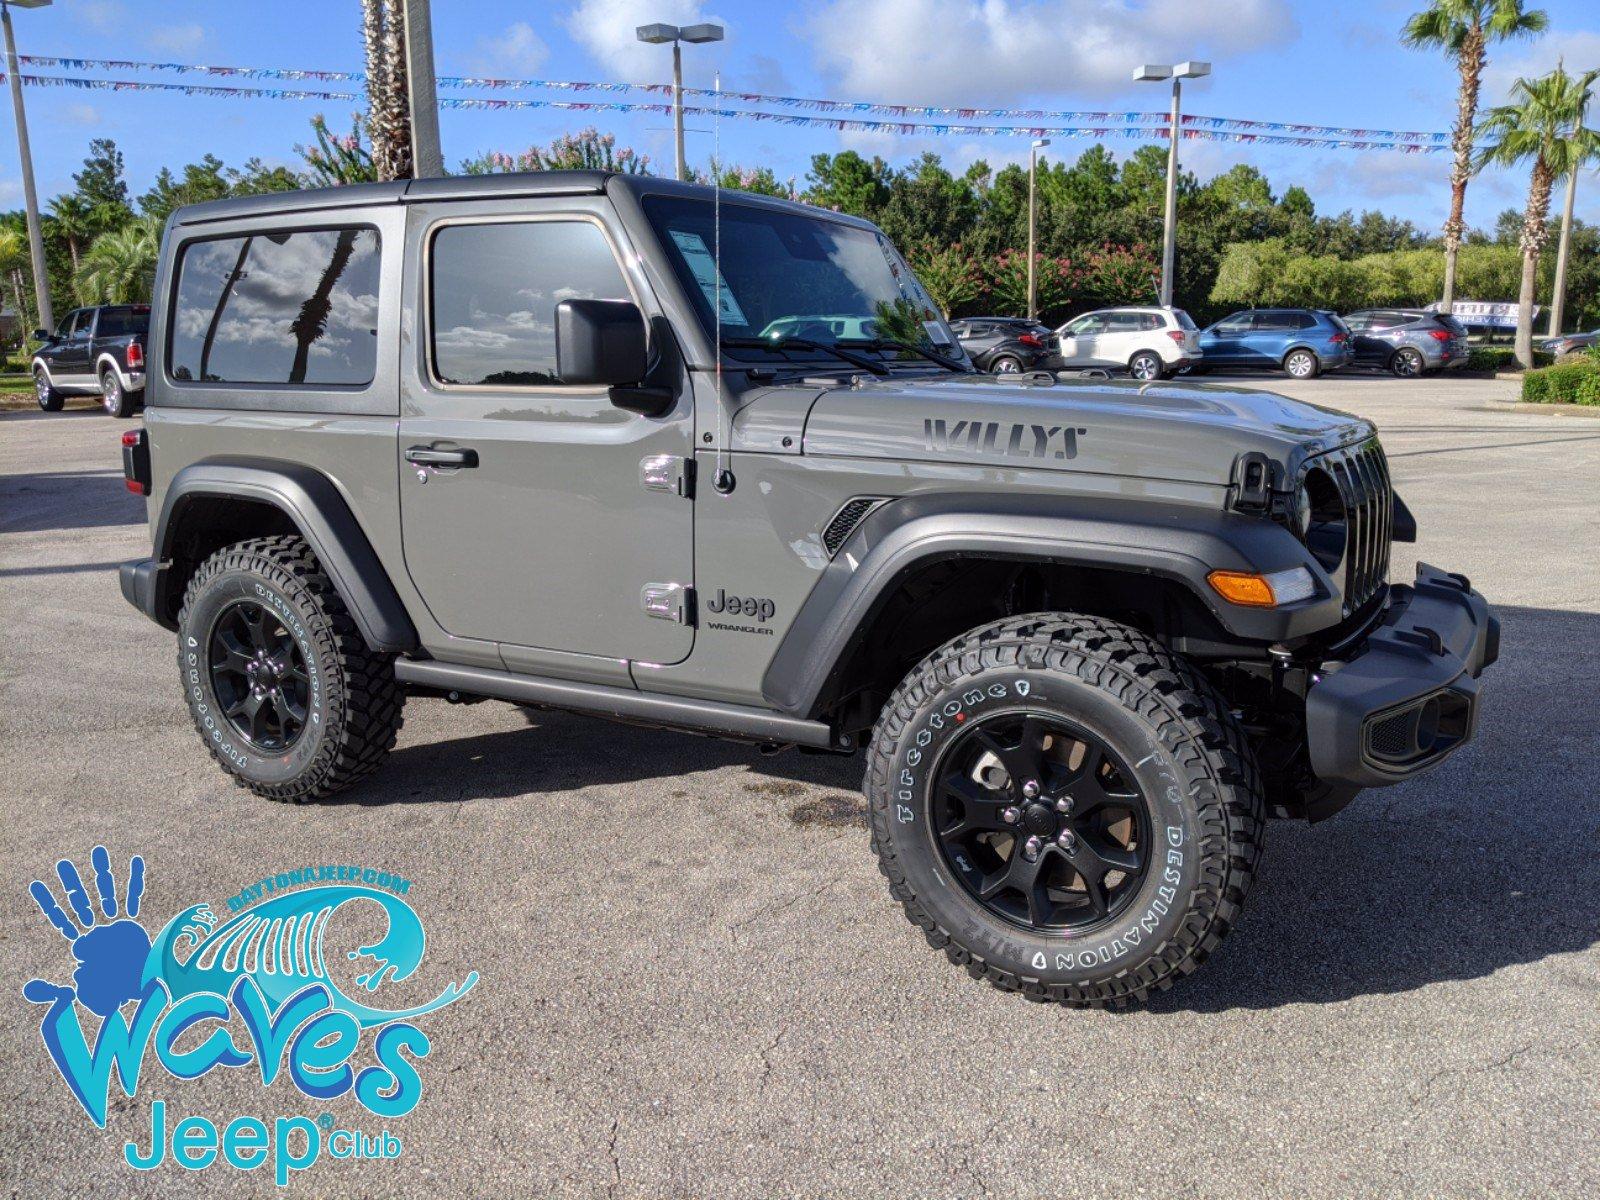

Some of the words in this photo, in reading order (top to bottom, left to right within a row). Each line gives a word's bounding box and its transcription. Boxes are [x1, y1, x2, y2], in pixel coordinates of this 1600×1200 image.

[924, 418, 1087, 460] WILLYS
[707, 589, 775, 622] Jeep
[707, 621, 774, 635] WRANGLER
[898, 681, 1007, 823] Firestone
[1055, 825, 1184, 970] DESTINATION
